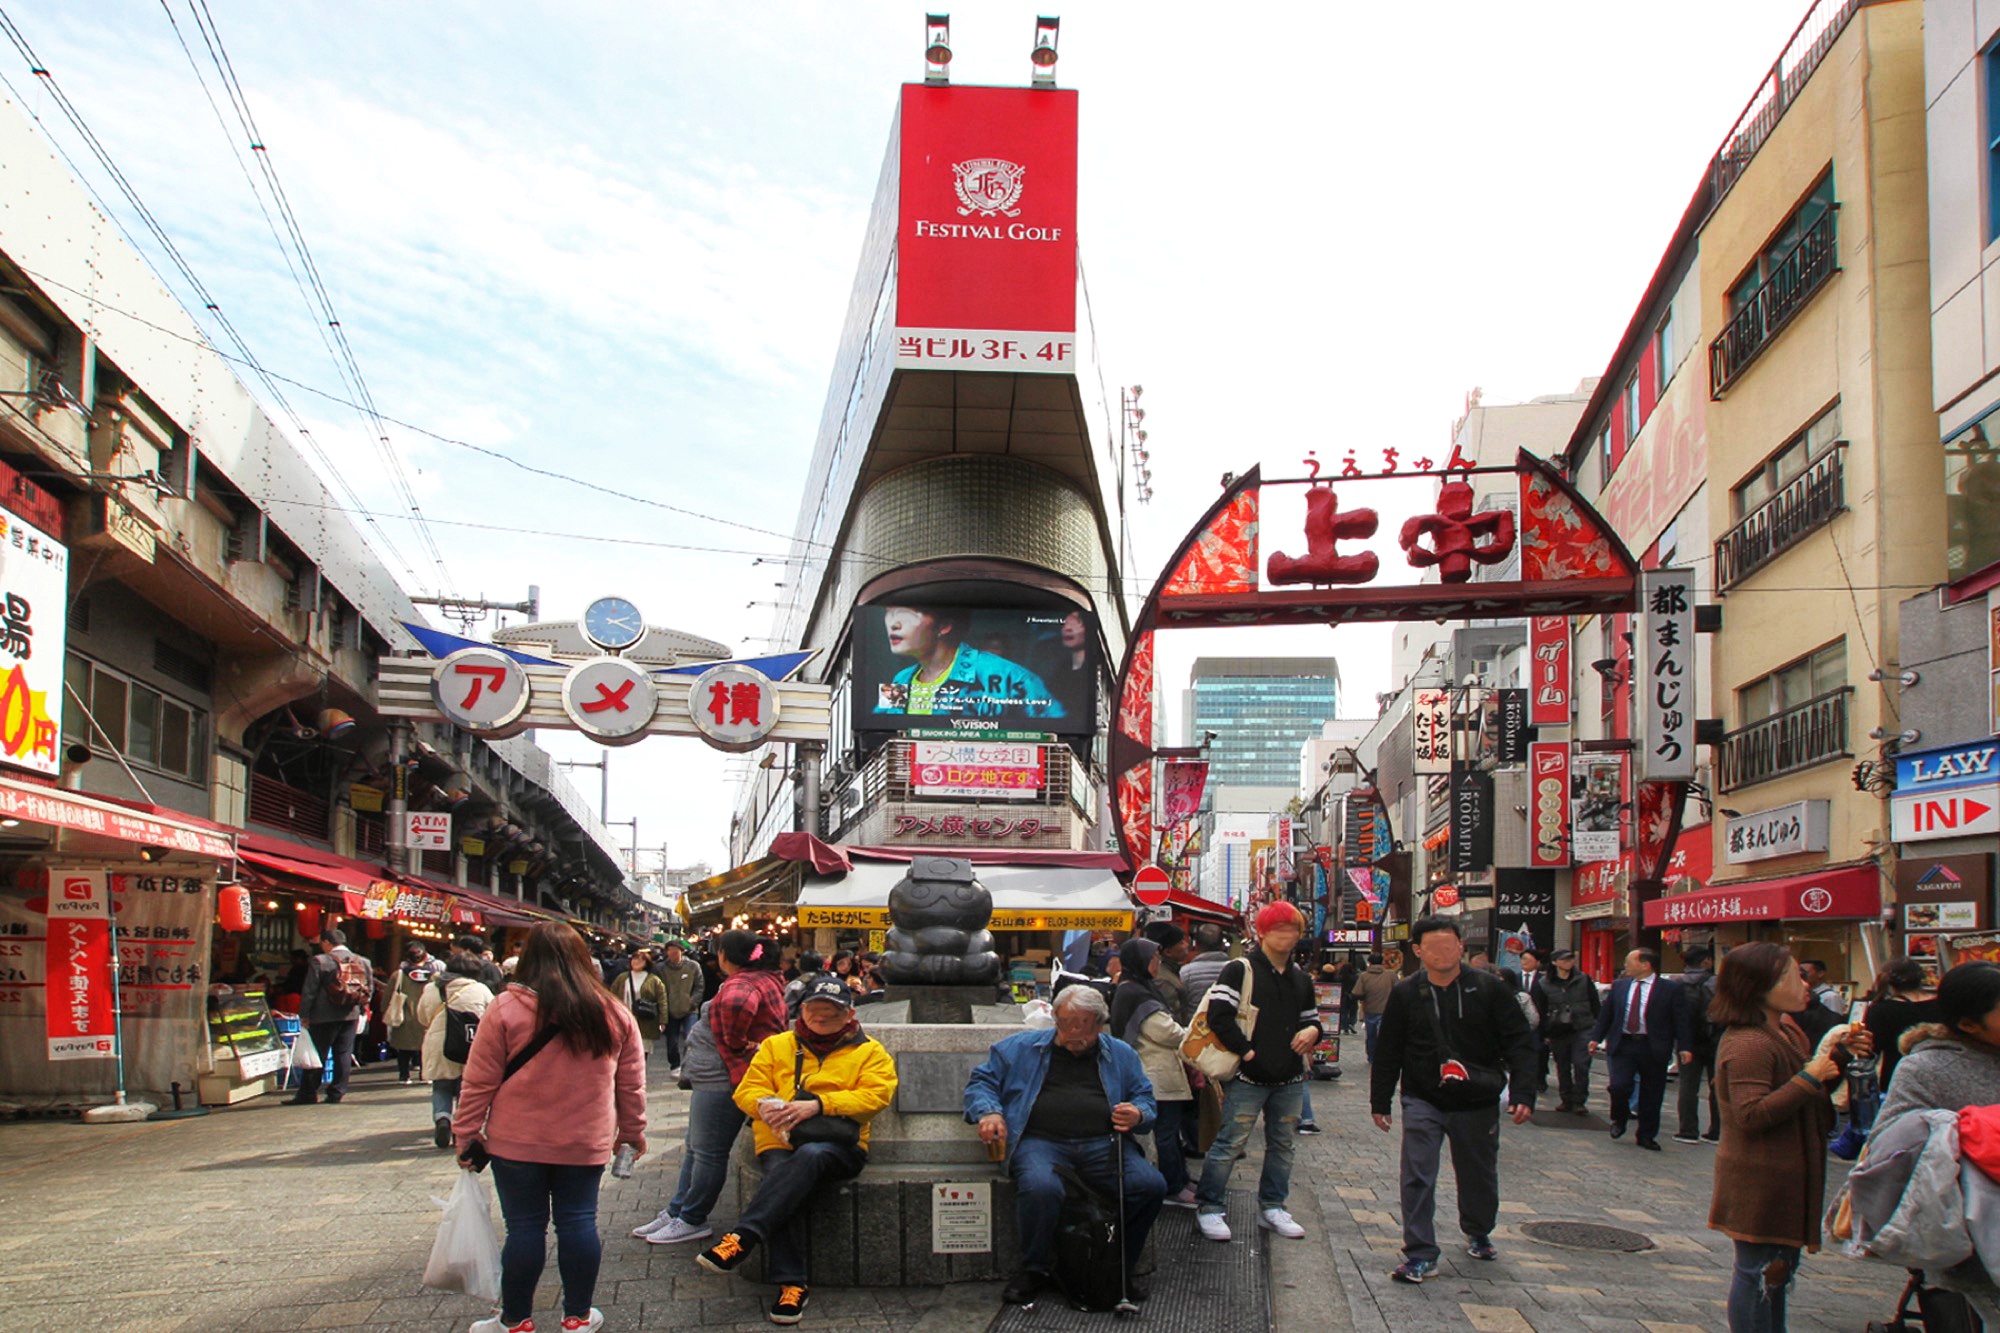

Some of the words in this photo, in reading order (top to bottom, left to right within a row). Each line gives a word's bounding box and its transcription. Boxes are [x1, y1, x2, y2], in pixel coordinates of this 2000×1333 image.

[915, 220, 1004, 240] FESTIVAL
[1008, 223, 1061, 241] GOLF
[1267, 481, 1516, 586] 上中
[1534, 639, 1566, 706] ゲーム
[1650, 585, 1687, 762] 都まんじゅう
[454, 663, 762, 727] アメ横
[1505, 703, 1515, 759] ROOMPIA
[947, 769, 1031, 785] ロケ地です
[1911, 747, 1996, 783] LAW
[411, 815, 448, 827] ATM
[895, 815, 1062, 838] アメ横センター
[1459, 792, 1473, 868] ROOMPIA
[1913, 798, 1957, 832] IN
[1729, 815, 1801, 853] 都まんじゅう
[1499, 893, 1552, 902] カンタン
[1499, 905, 1551, 915] 部屋さがし
[807, 911, 872, 924] たらばがに
